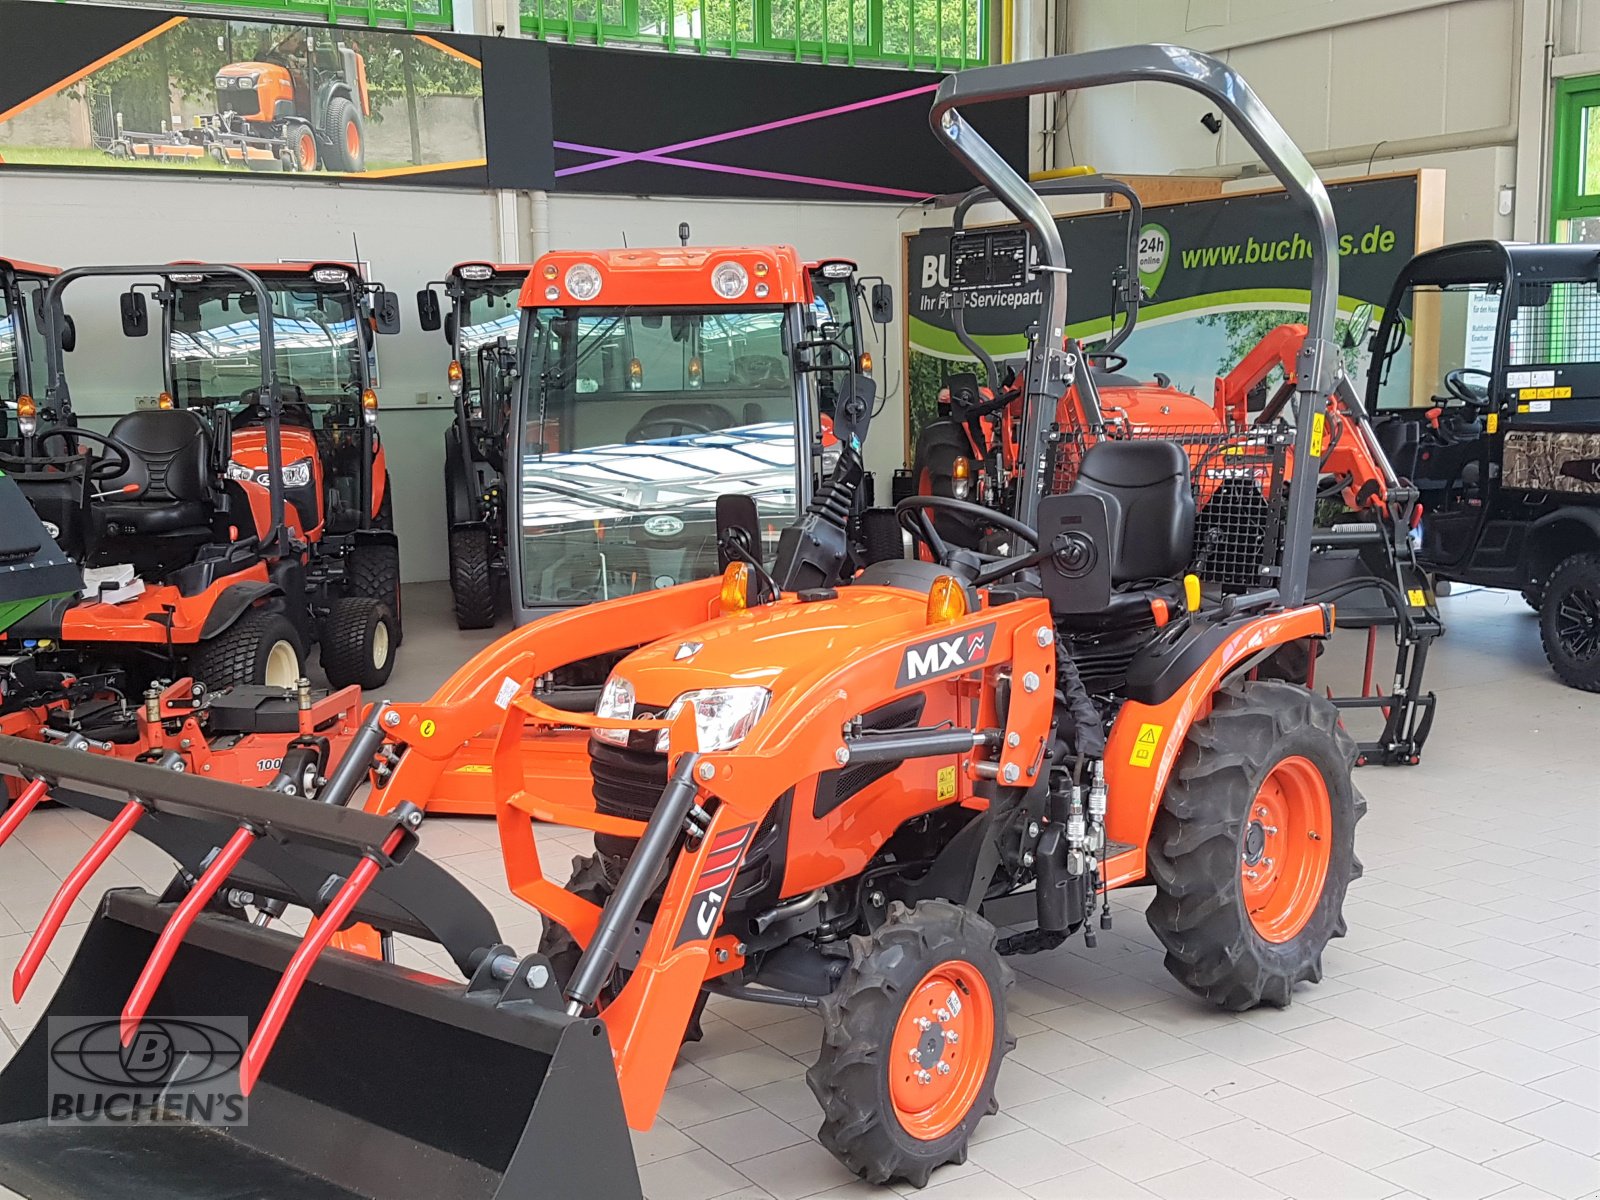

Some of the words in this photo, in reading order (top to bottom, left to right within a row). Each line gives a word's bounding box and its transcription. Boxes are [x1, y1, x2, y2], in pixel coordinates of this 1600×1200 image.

[1140, 237, 1164, 253] 24h
[1182, 225, 1395, 268] www.buchs.de
[1140, 256, 1161, 265] online
[920, 295, 936, 310] Ihr
[906, 636, 965, 680] MX
